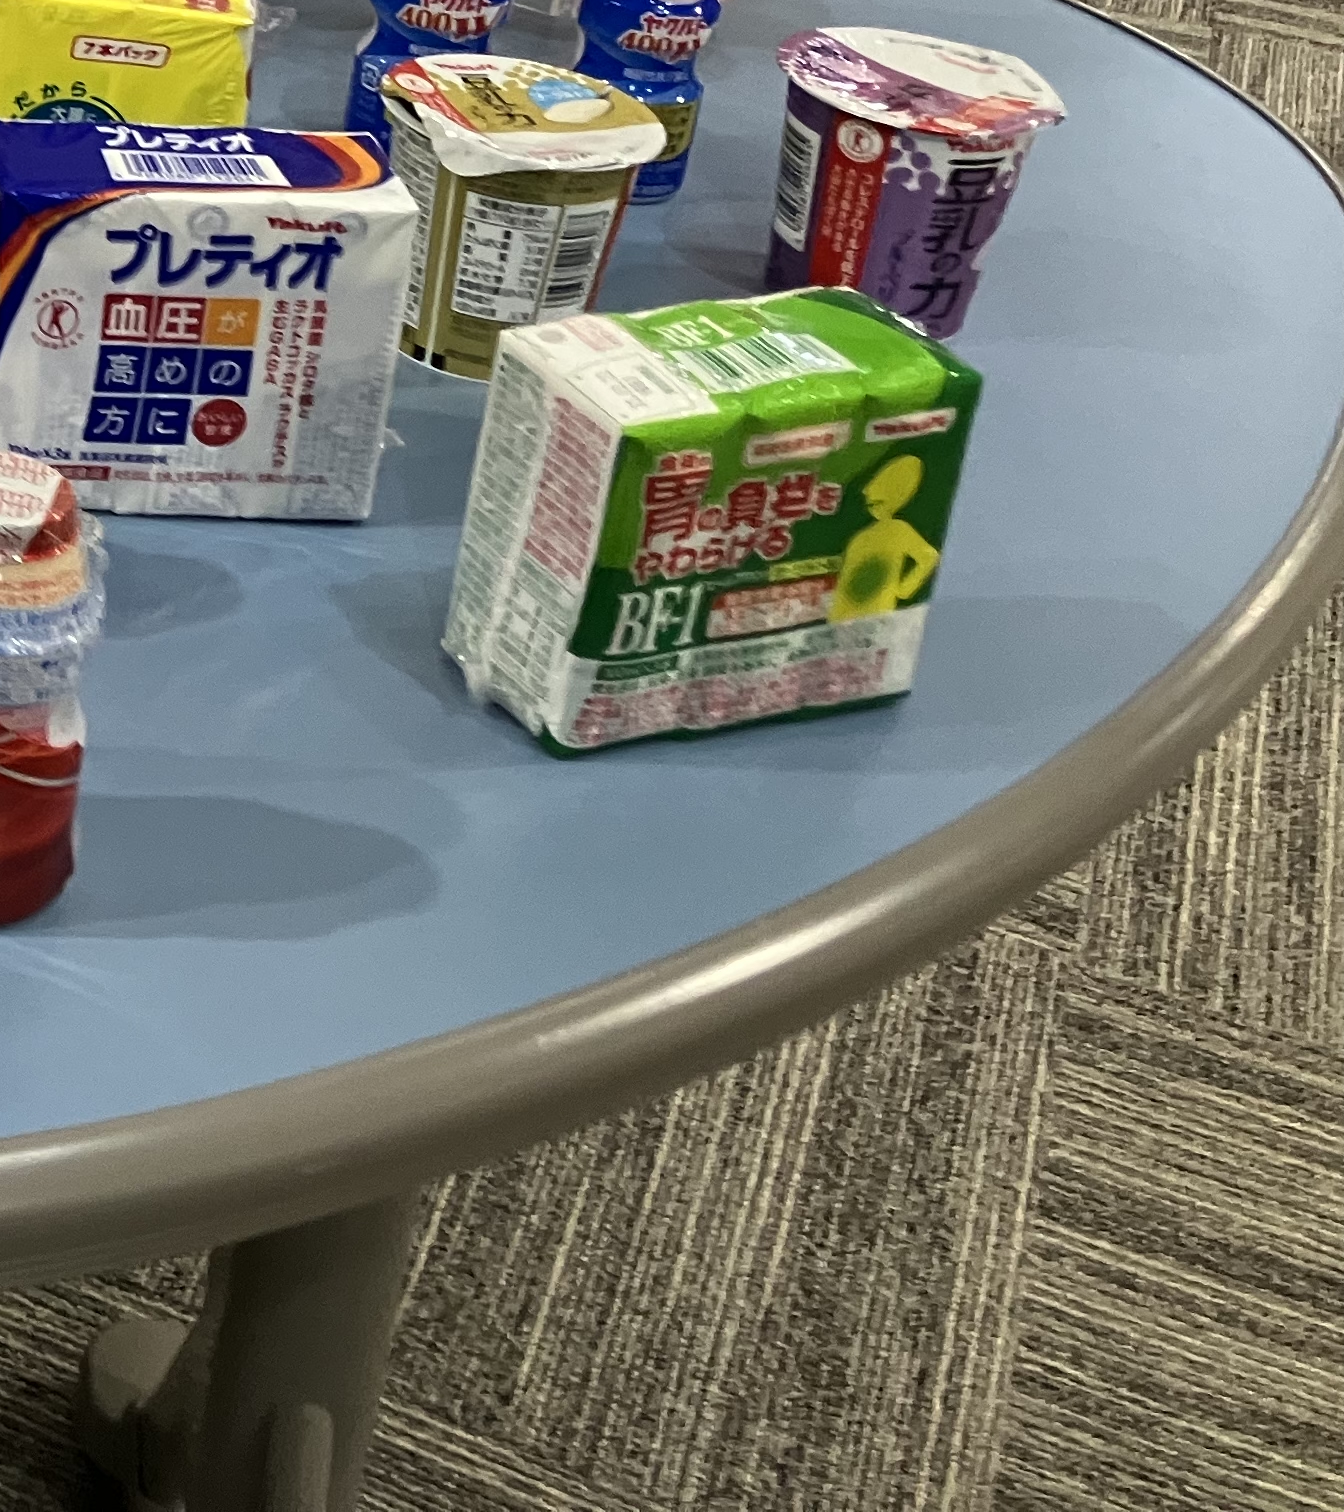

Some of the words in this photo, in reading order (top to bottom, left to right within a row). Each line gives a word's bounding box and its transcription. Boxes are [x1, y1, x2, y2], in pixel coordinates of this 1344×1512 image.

[98, 127, 256, 152] プレティオ
[105, 223, 344, 289] プレティオ
[104, 298, 248, 341] 血圧が
[104, 353, 242, 387] 高めの
[92, 405, 180, 437] 方に
